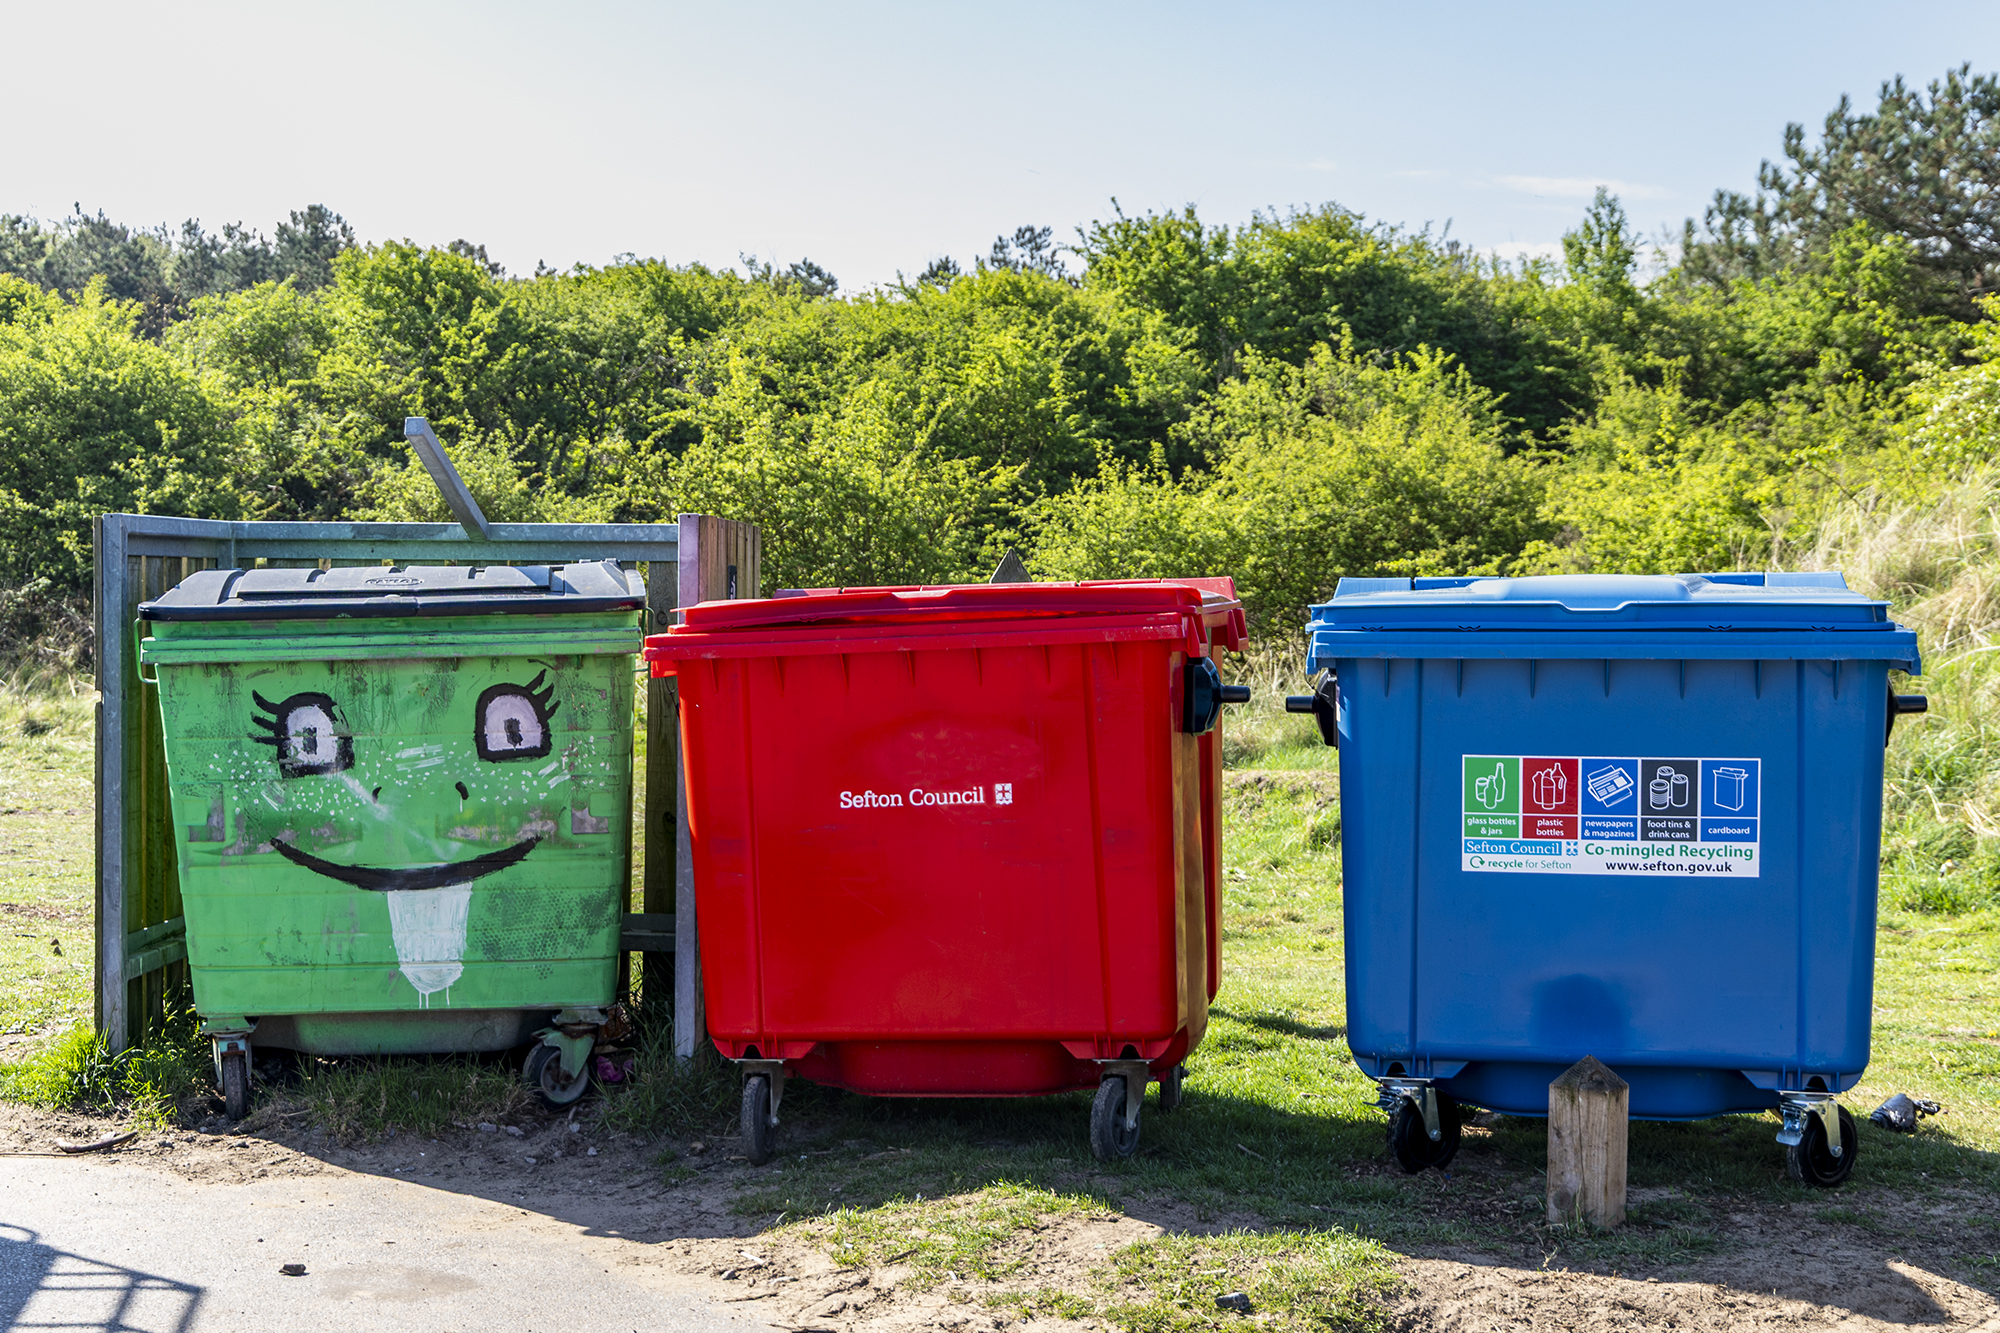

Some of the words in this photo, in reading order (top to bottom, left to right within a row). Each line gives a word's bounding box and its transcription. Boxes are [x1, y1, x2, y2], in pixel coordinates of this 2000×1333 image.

[839, 790, 904, 809] Sefton
[909, 786, 985, 806] Council
[1467, 817, 1487, 827] glass
[1488, 817, 1517, 826] bottles
[1537, 818, 1564, 828] plastic
[1585, 819, 1634, 829] newspapers
[1647, 820, 1667, 829] food
[1667, 821, 1683, 829] tins
[1684, 821, 1691, 829] &
[1480, 827, 1487, 835] &
[1487, 827, 1503, 836] jars
[1536, 828, 1565, 837] bottles
[1584, 829, 1591, 837] &
[1591, 830, 1635, 839] magazines
[1648, 830, 1670, 839] drink
[1670, 831, 1690, 839] cans
[1707, 826, 1750, 835] cardboard
[1466, 840, 1507, 853] Sefton
[1510, 842, 1560, 855] Council
[1584, 842, 1675, 860] Co-mingled
[1679, 844, 1754, 861] Recycling
[1488, 859, 1523, 869] recycle
[1525, 859, 1539, 868] for
[1540, 860, 1572, 869] Sefton
[1605, 860, 1733, 875] www.sefton.gov.uk
